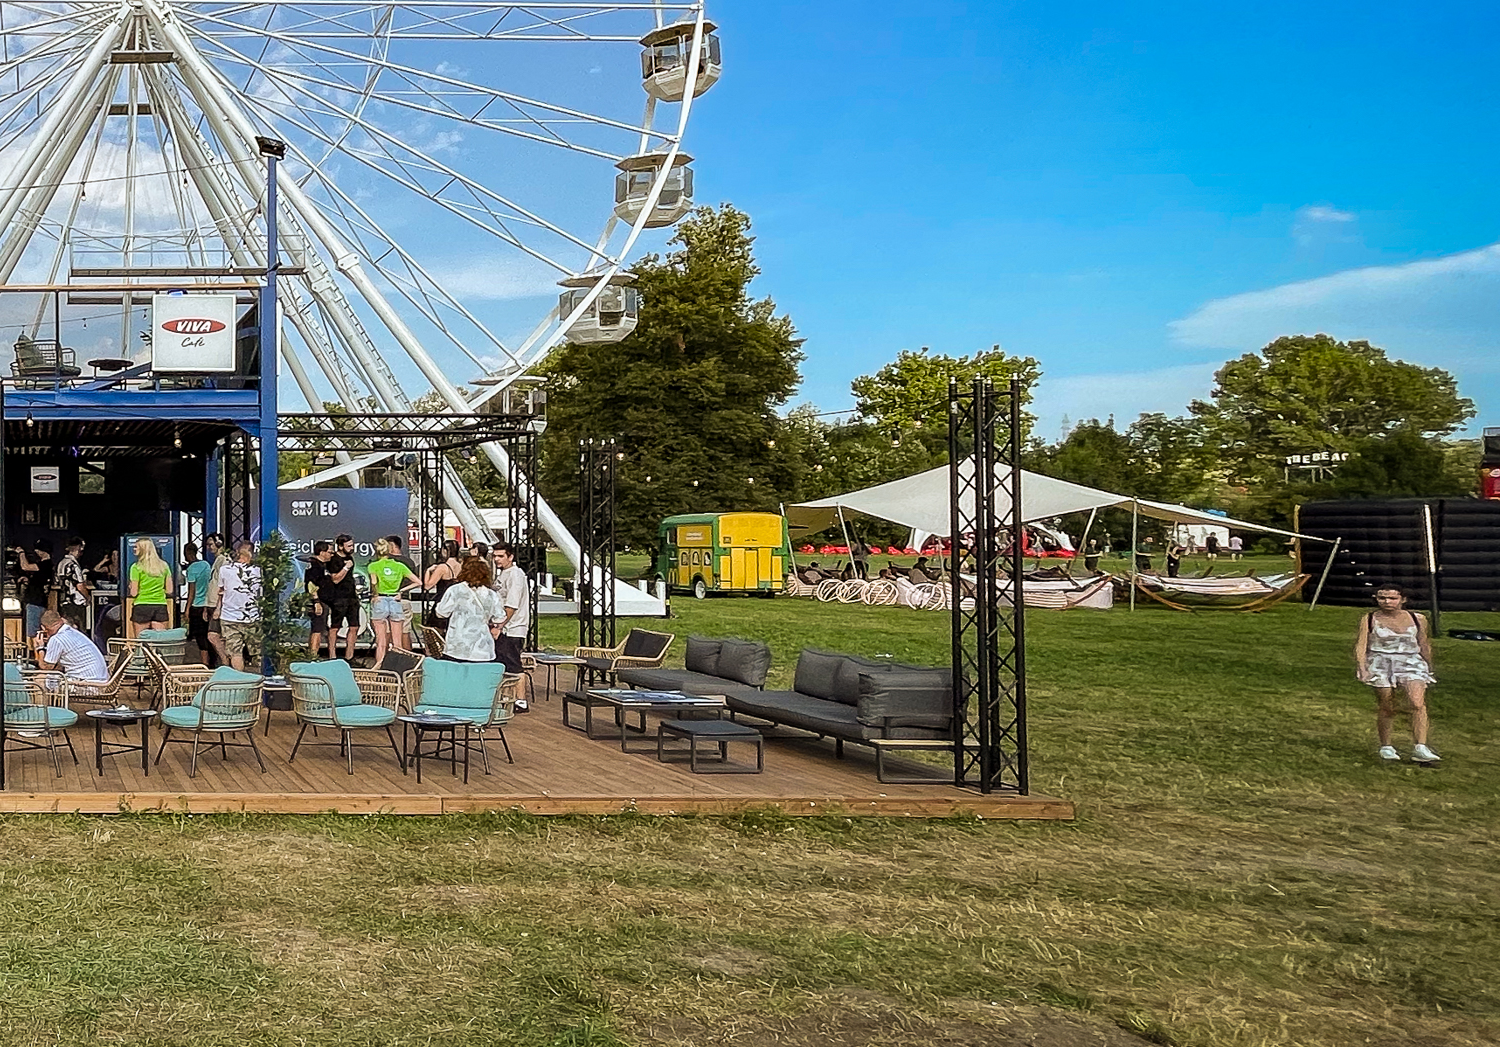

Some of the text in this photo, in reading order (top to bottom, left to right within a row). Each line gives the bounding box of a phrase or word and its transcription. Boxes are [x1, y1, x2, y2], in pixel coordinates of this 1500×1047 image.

[176, 320, 211, 332] VIVA
[291, 508, 313, 516] OMV
[320, 501, 338, 516] EC
